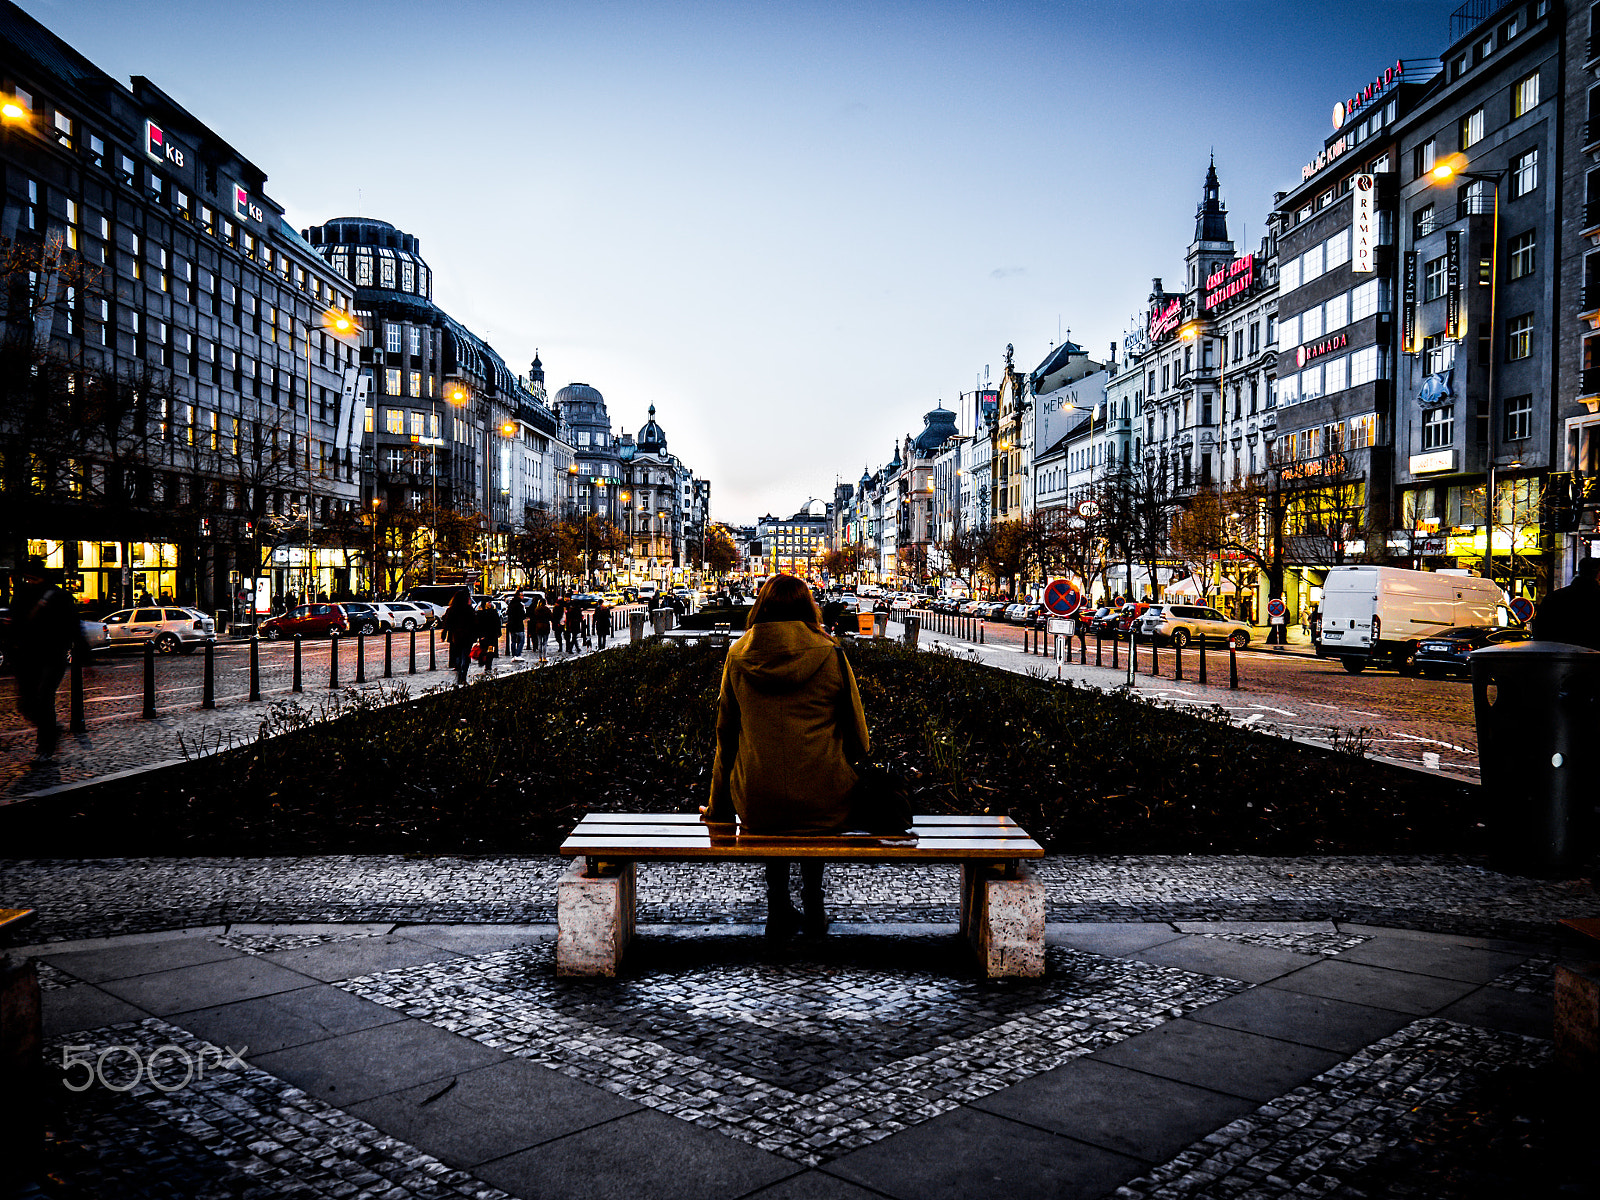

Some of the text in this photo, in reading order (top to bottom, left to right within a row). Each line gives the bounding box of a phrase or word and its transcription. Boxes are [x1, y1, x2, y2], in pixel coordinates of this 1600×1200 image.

[1346, 59, 1403, 115] RAMADA
[165, 142, 184, 167] KB
[1327, 134, 1347, 166] KNIH
[248, 202, 263, 223] KB
[1359, 198, 1370, 271] RAMADA
[1306, 333, 1347, 360] RAMADA
[1043, 390, 1078, 415] MERAN
